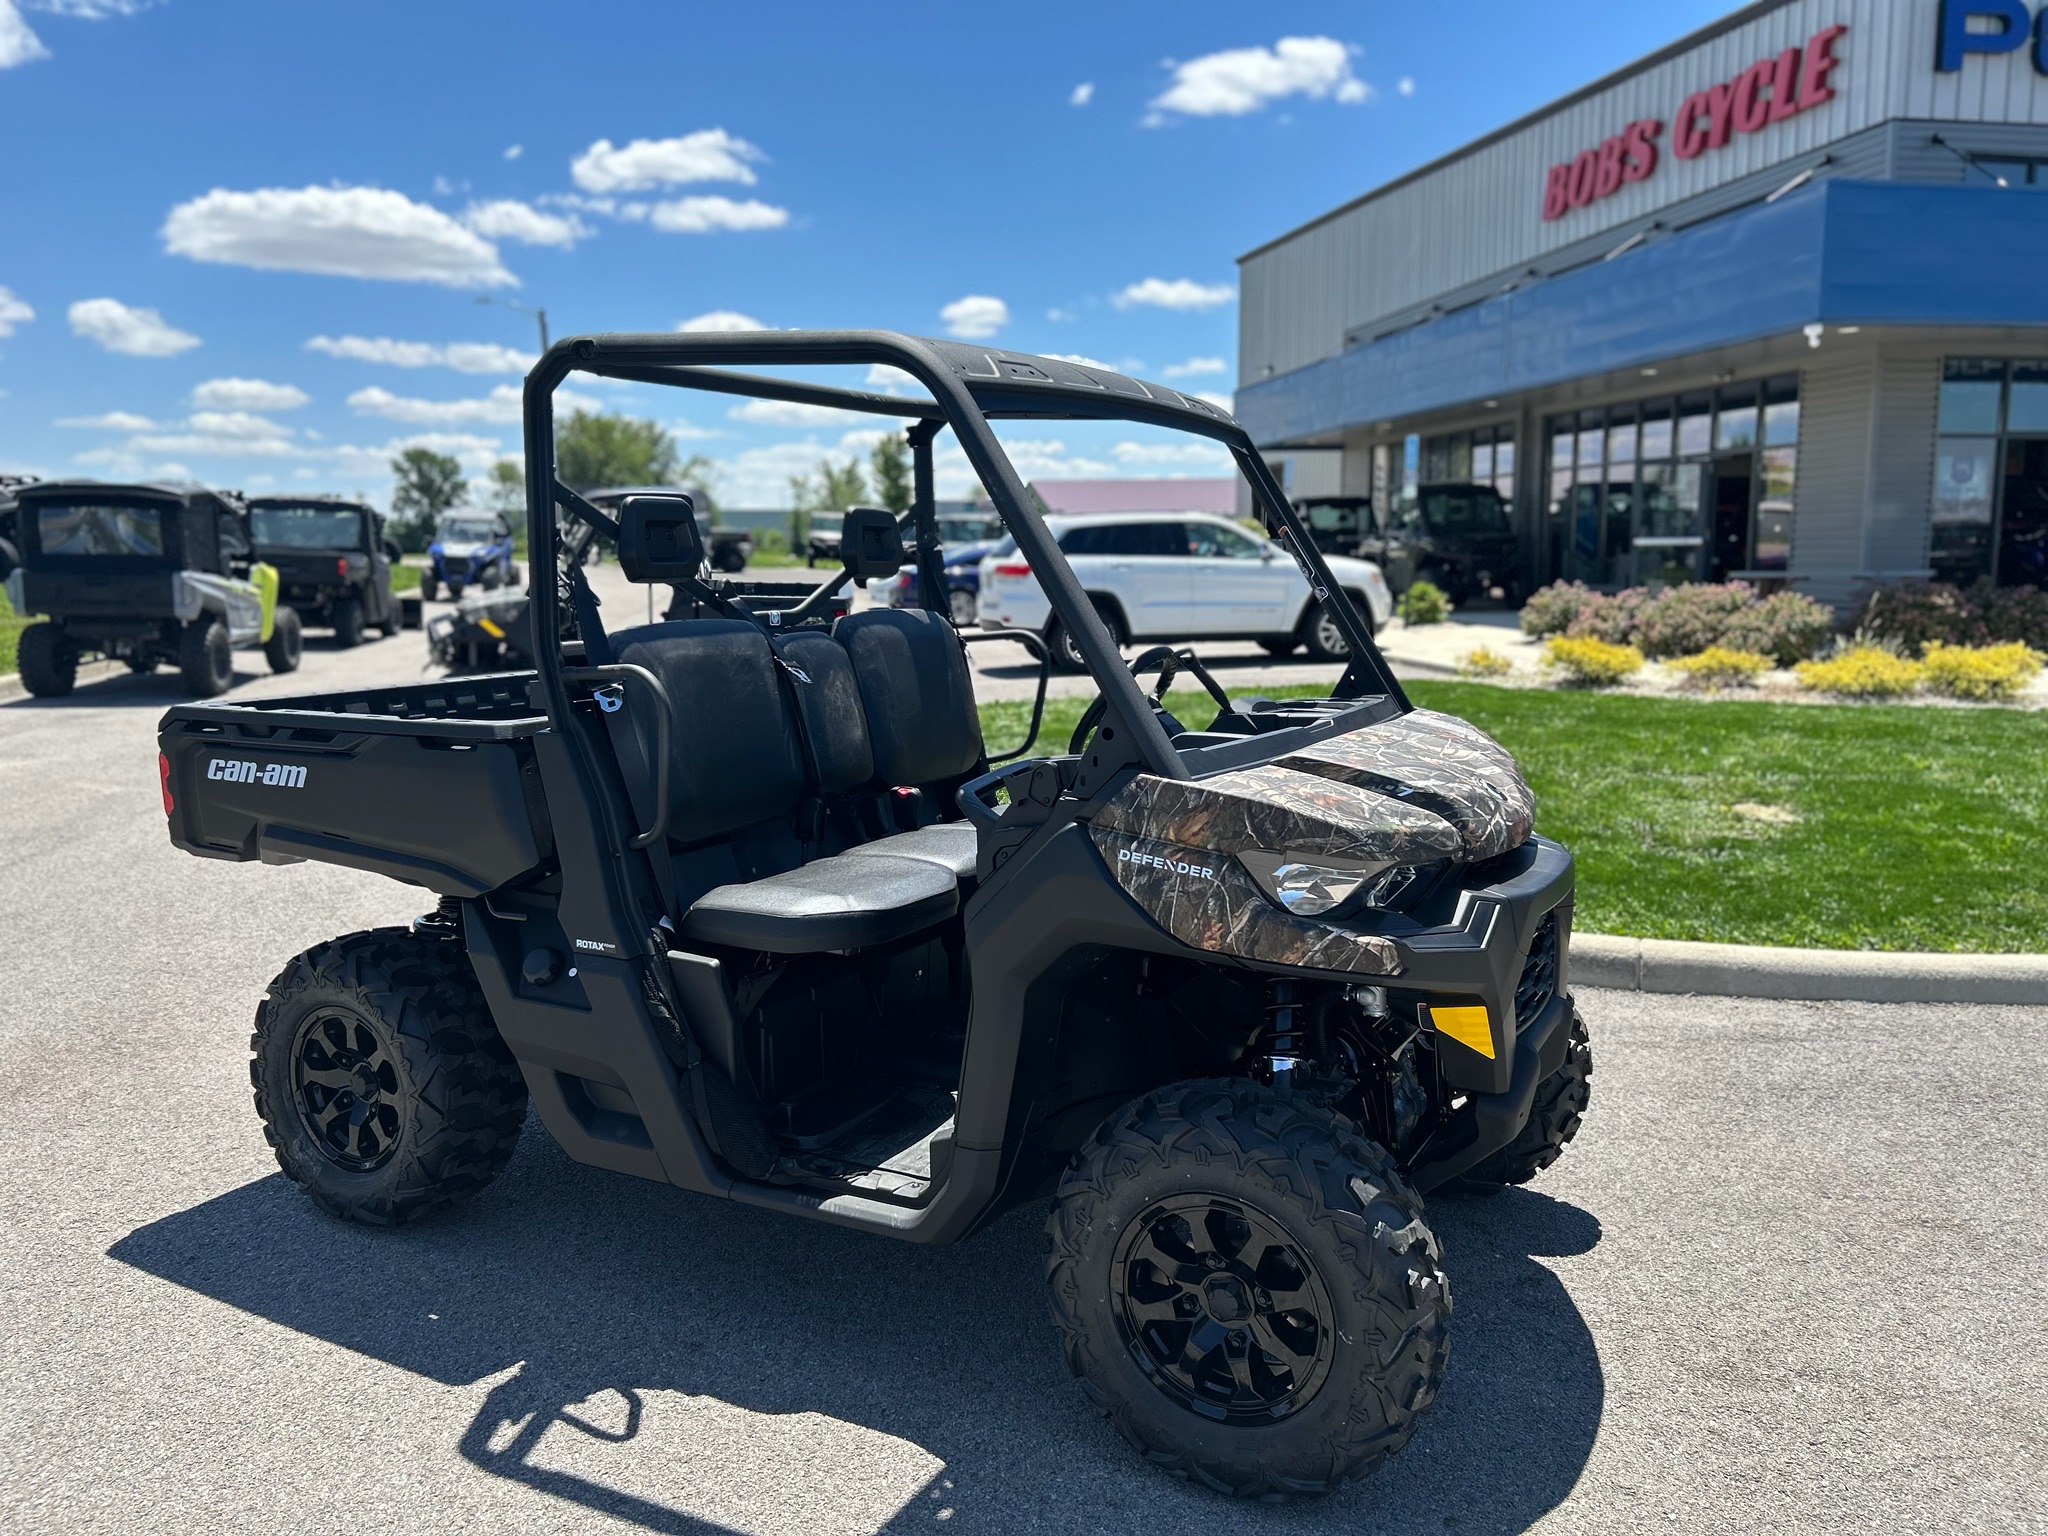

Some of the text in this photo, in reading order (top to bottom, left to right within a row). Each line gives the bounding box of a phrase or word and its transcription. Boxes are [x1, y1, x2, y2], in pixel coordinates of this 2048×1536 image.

[1934, 0, 2048, 77] P
[1542, 24, 1847, 221] BOB'S CYCLE
[207, 758, 308, 788] can-am
[1119, 849, 1214, 879] DEFENDER
[576, 939, 604, 951] ROTAX
